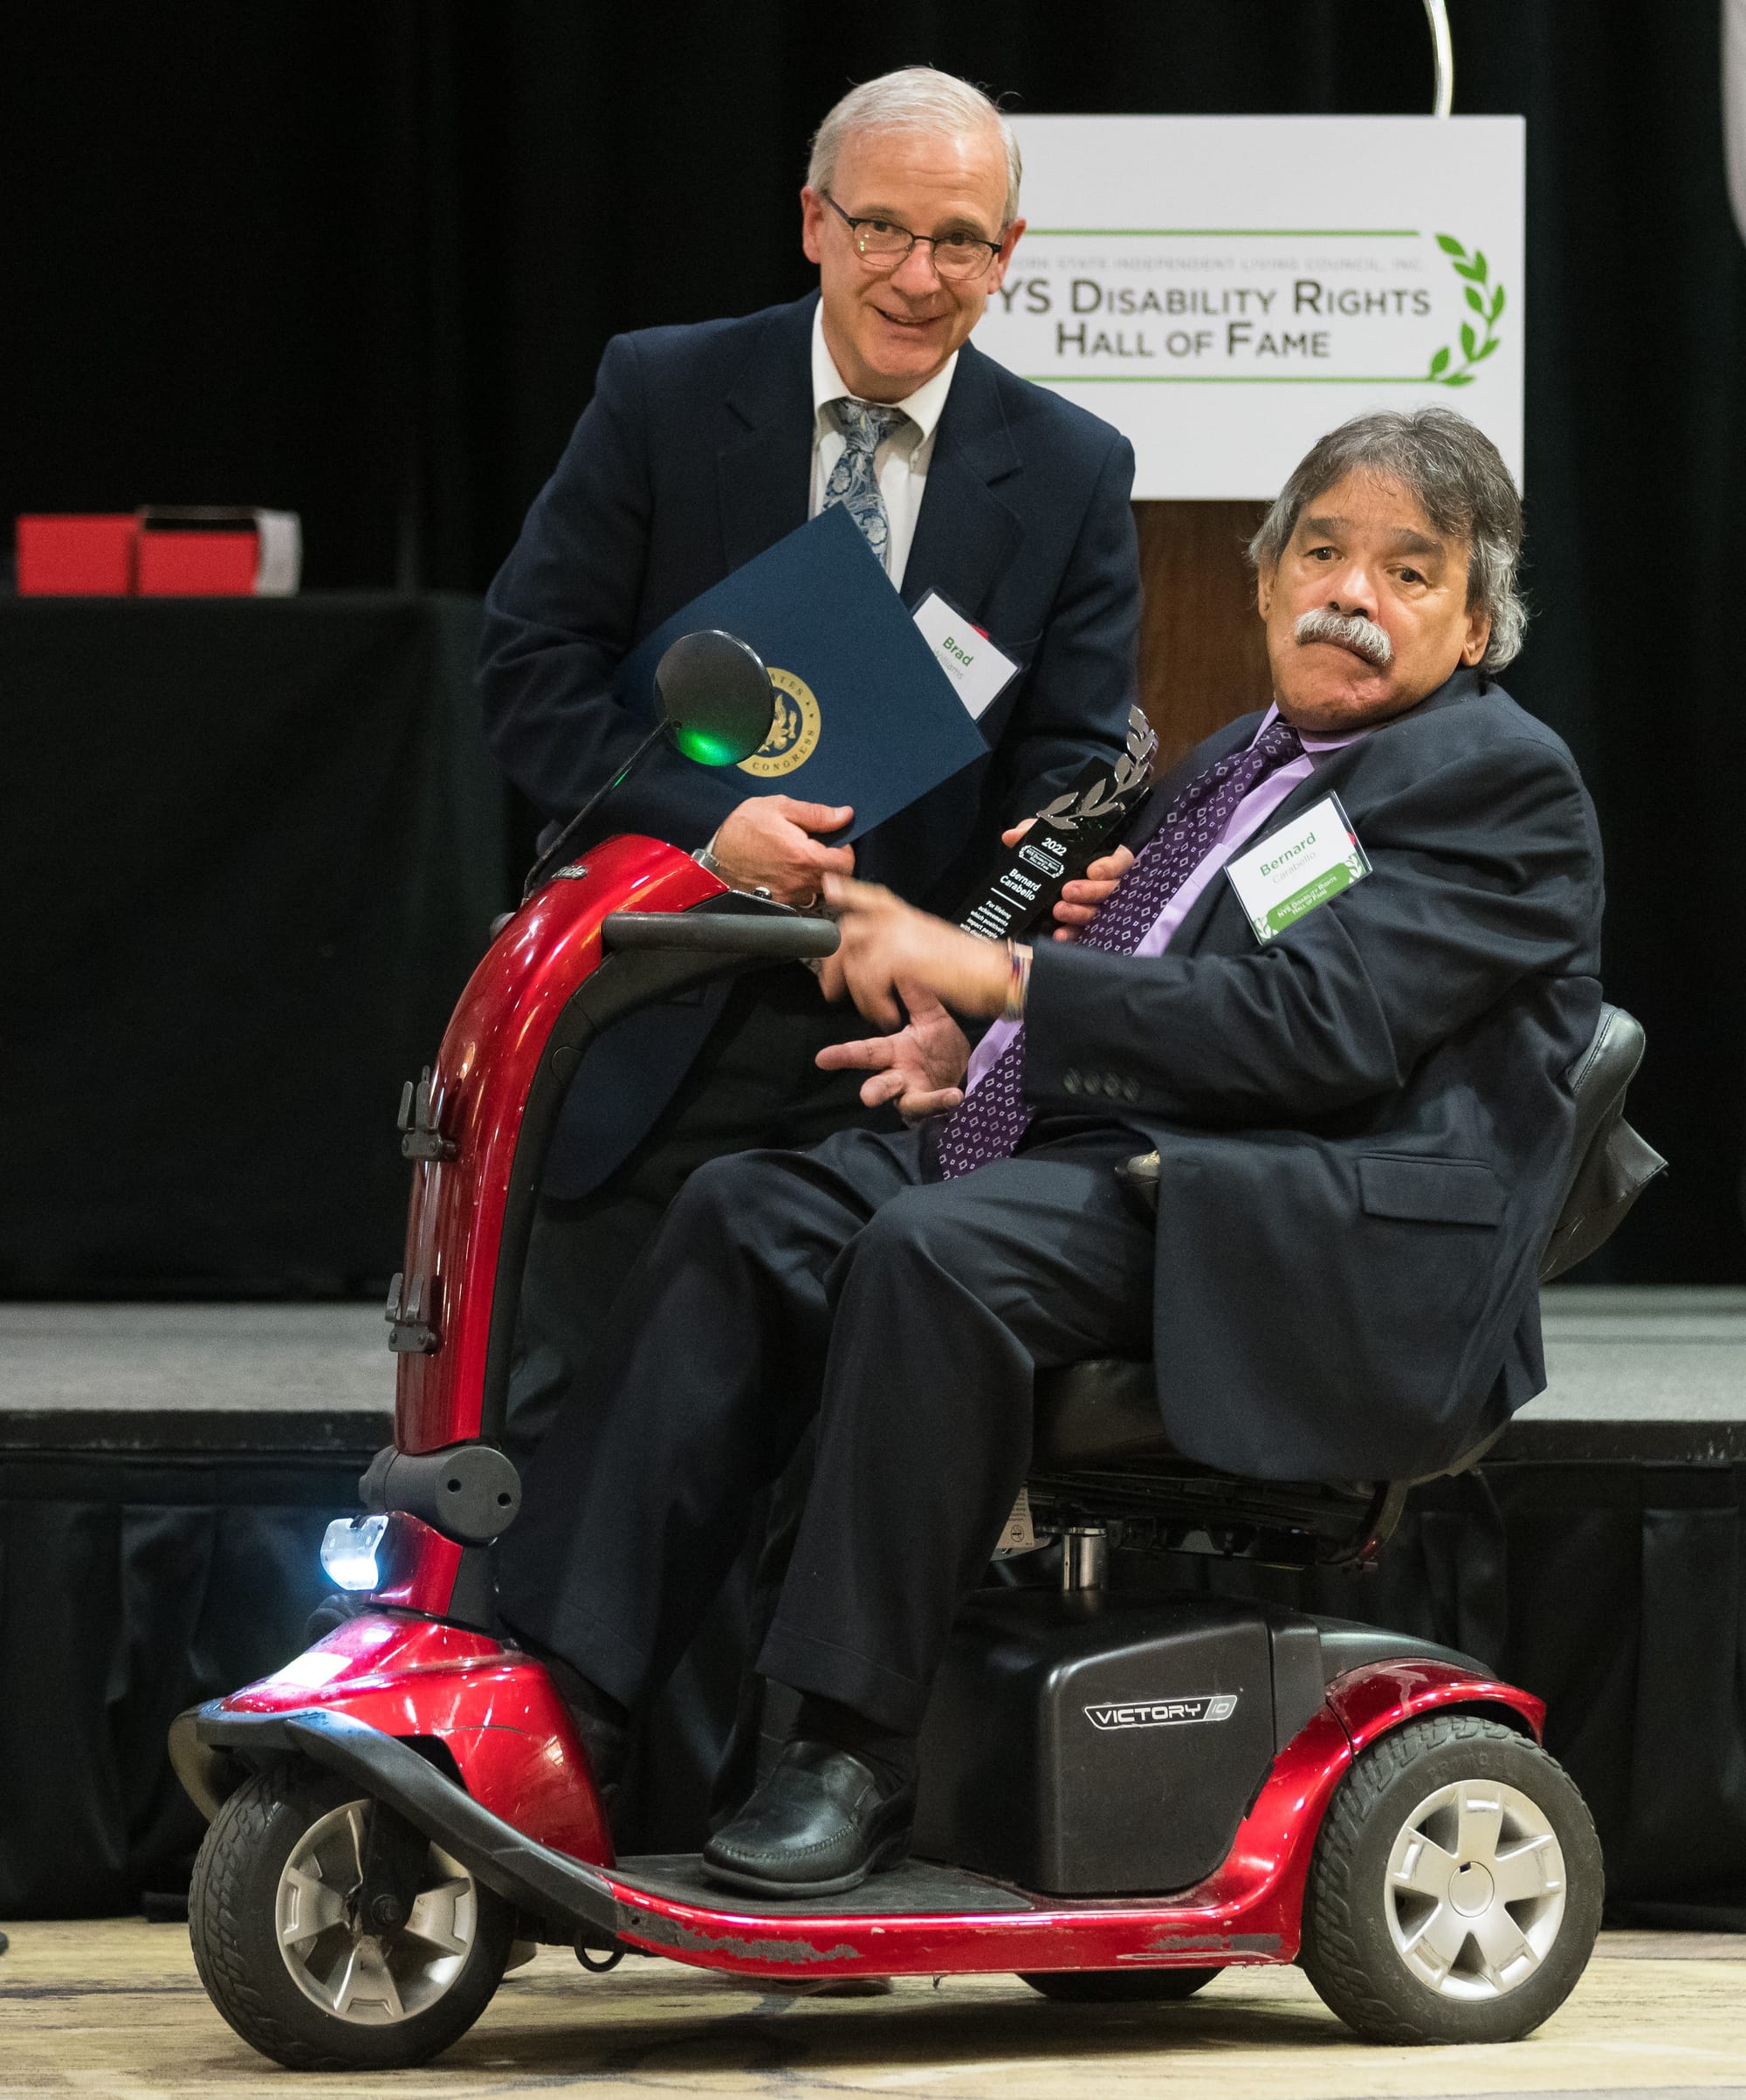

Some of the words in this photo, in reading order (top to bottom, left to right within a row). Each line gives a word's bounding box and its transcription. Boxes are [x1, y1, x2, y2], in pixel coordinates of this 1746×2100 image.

[996, 278, 1051, 312] YS
[1071, 278, 1277, 313] DISABILITY
[1294, 278, 1431, 313] RIGHTS
[1056, 322, 1154, 357] HALL
[1166, 331, 1214, 357] OF
[1227, 322, 1330, 357] FAME
[943, 636, 974, 667] Brad
[1041, 837, 1067, 856] 2022
[1259, 832, 1316, 876] Bernard
[1000, 875, 1035, 901] Carabello
[1009, 868, 1041, 891] Bernard
[1096, 1704, 1201, 1725] VICTORY
